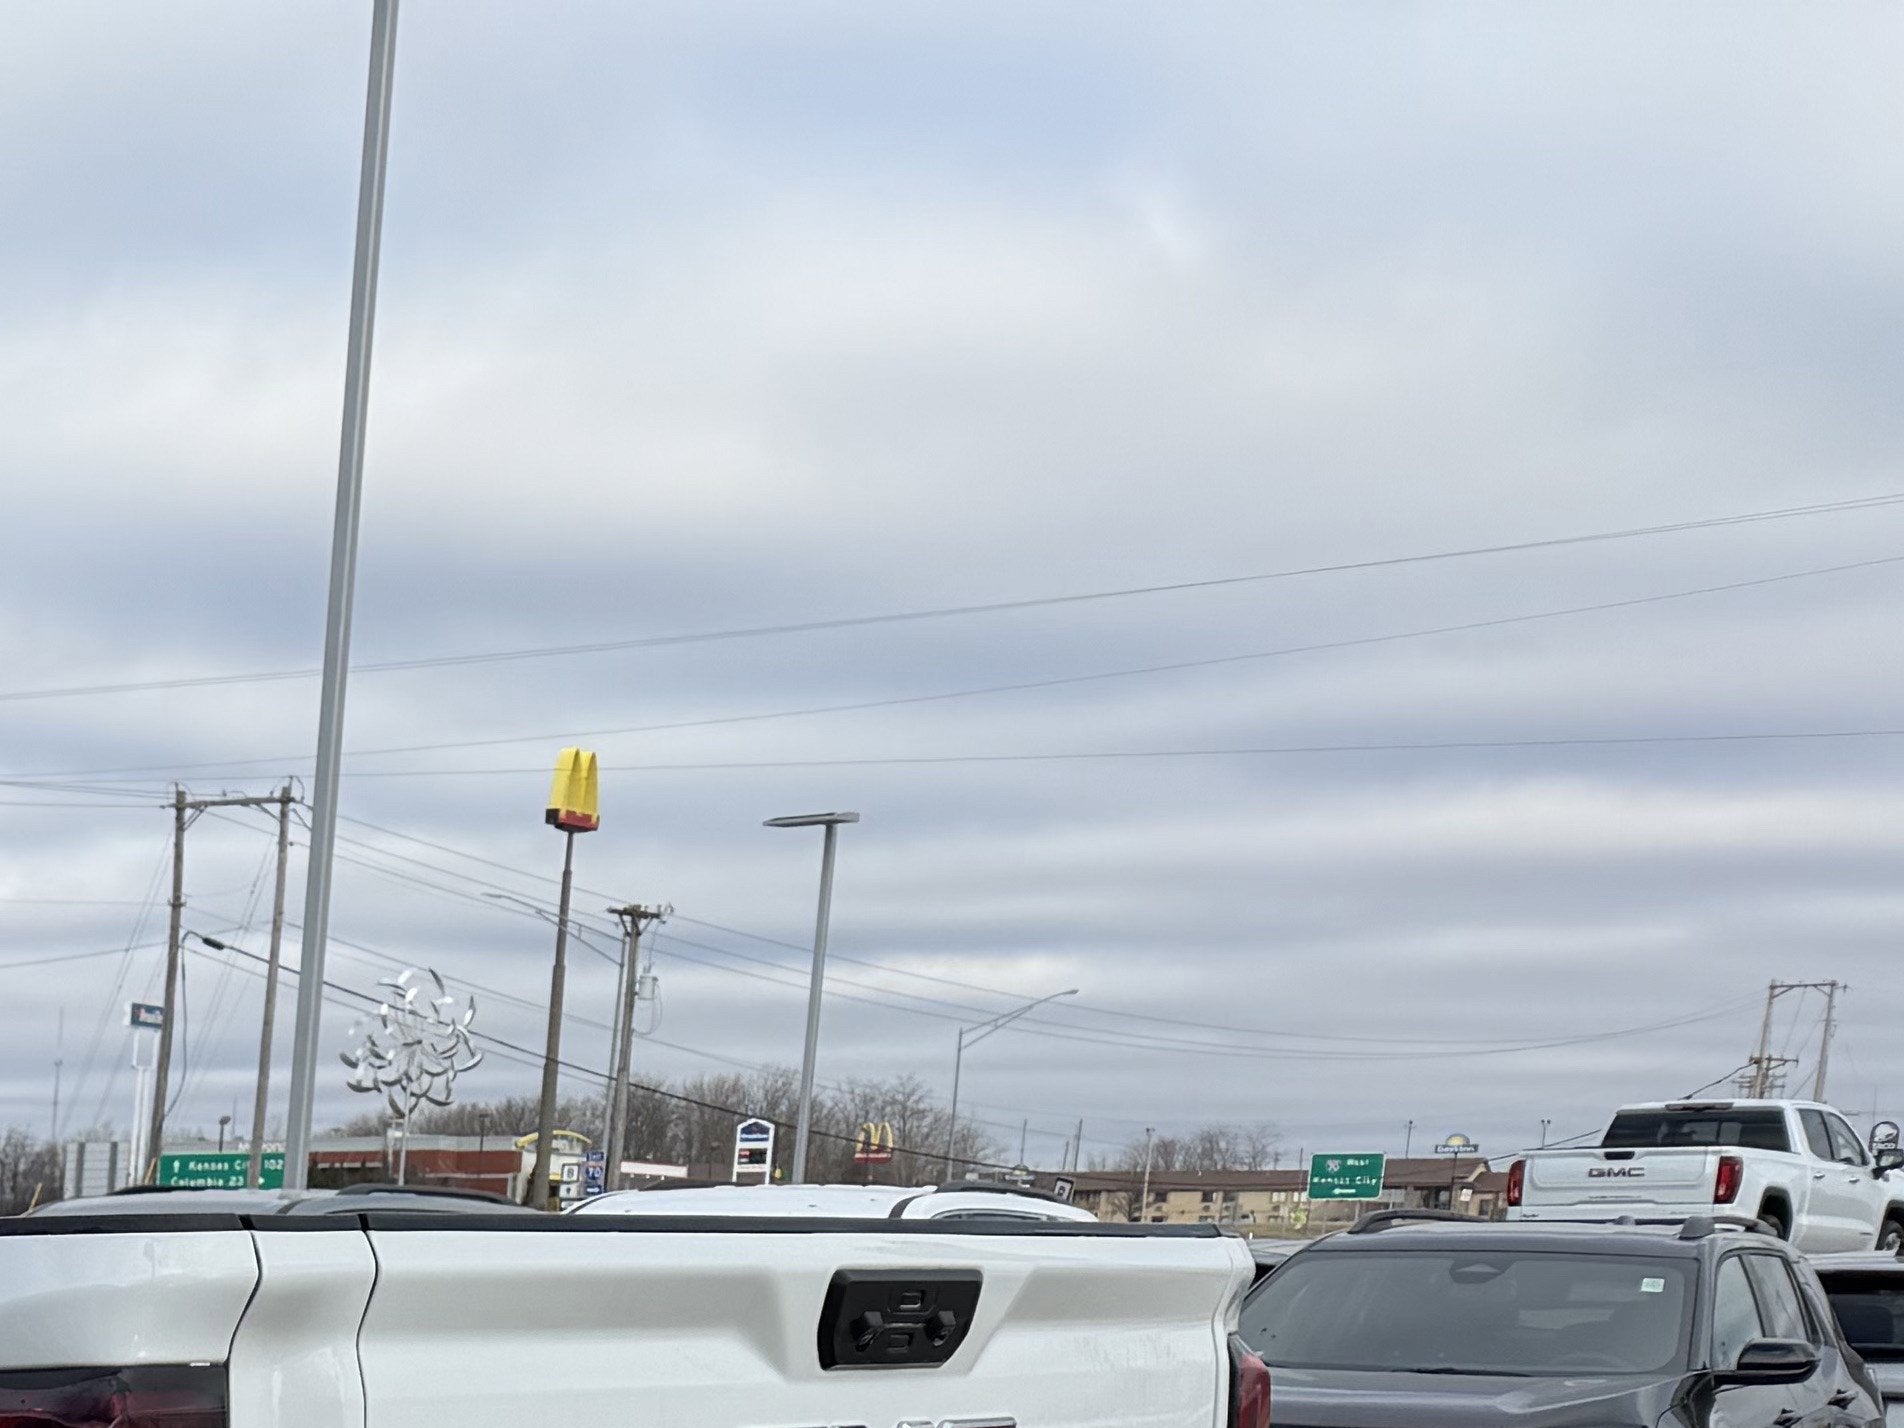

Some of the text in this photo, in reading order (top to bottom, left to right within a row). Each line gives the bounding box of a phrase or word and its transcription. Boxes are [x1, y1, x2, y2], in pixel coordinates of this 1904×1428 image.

[188, 1160, 229, 1171] Kansas
[1588, 1167, 1645, 1178] GMC
[171, 1176, 224, 1187] Columbia
